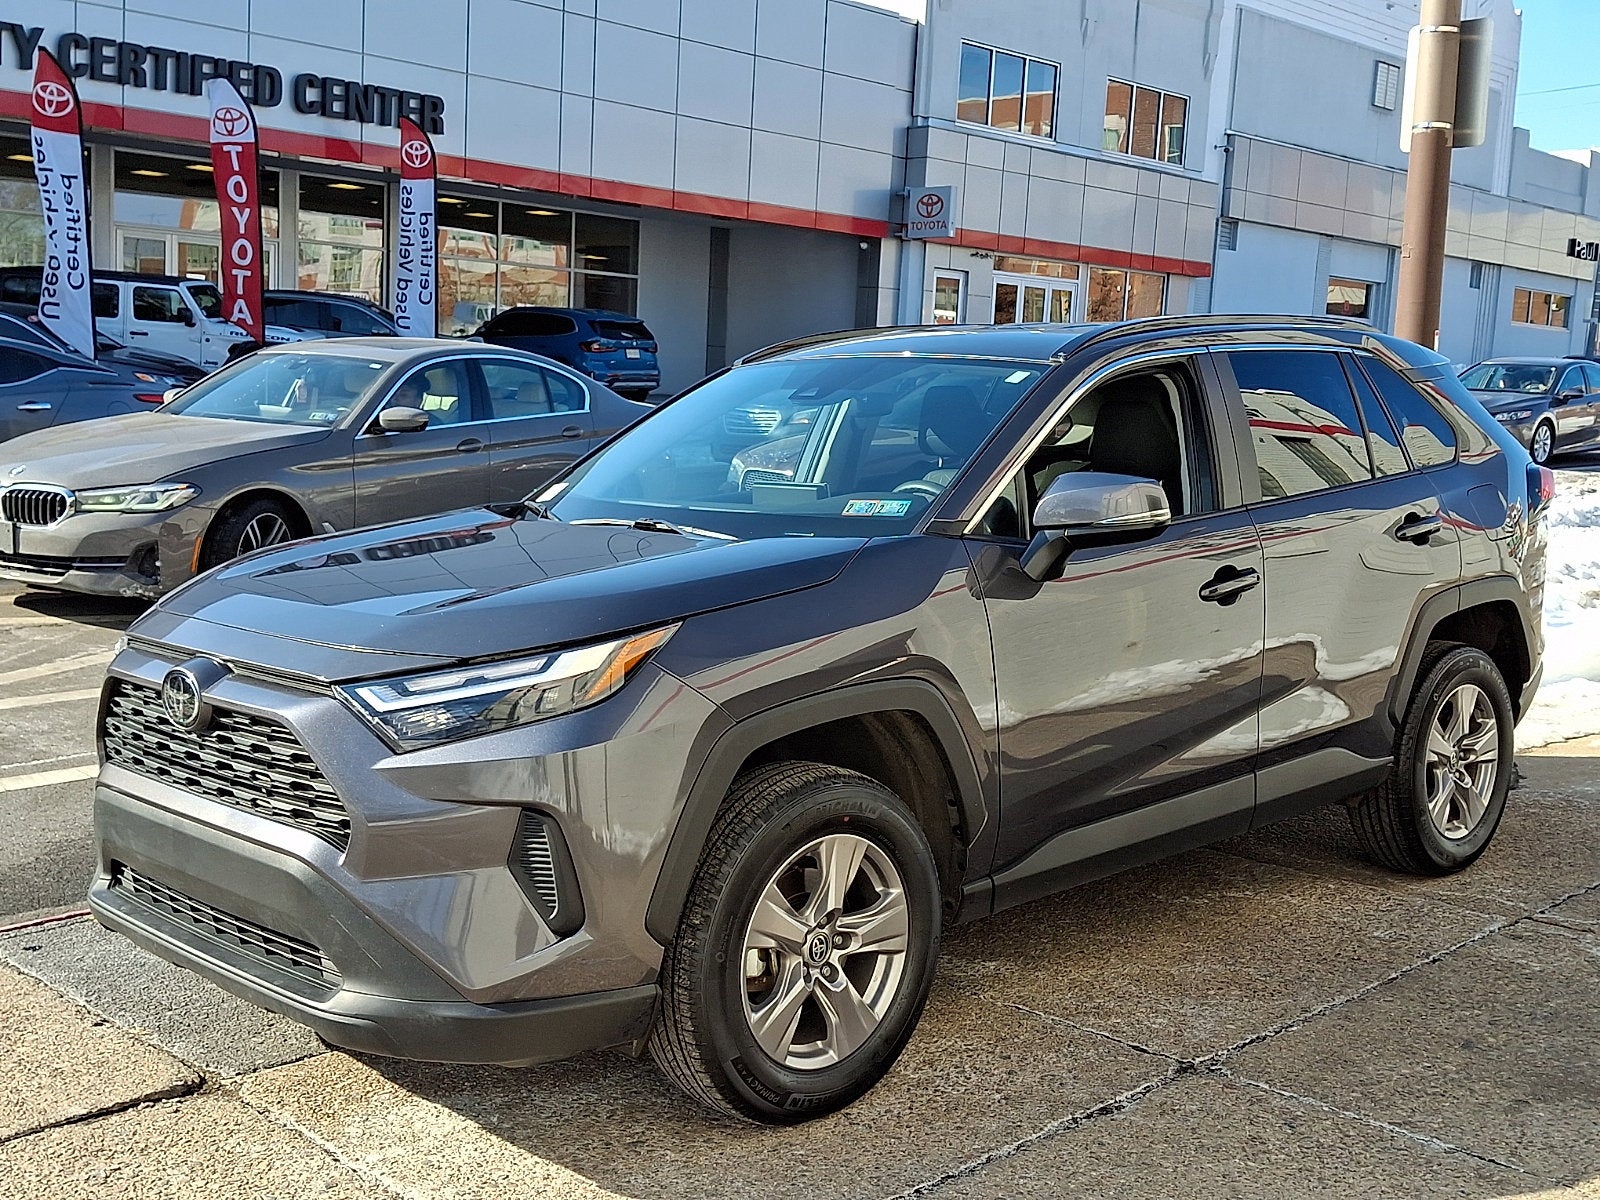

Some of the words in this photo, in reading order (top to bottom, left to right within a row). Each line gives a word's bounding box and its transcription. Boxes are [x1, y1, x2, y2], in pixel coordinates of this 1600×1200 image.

[294, 73, 445, 135] CENTER
[223, 144, 254, 326] TOYOTA
[910, 220, 948, 231] TOYOTA
